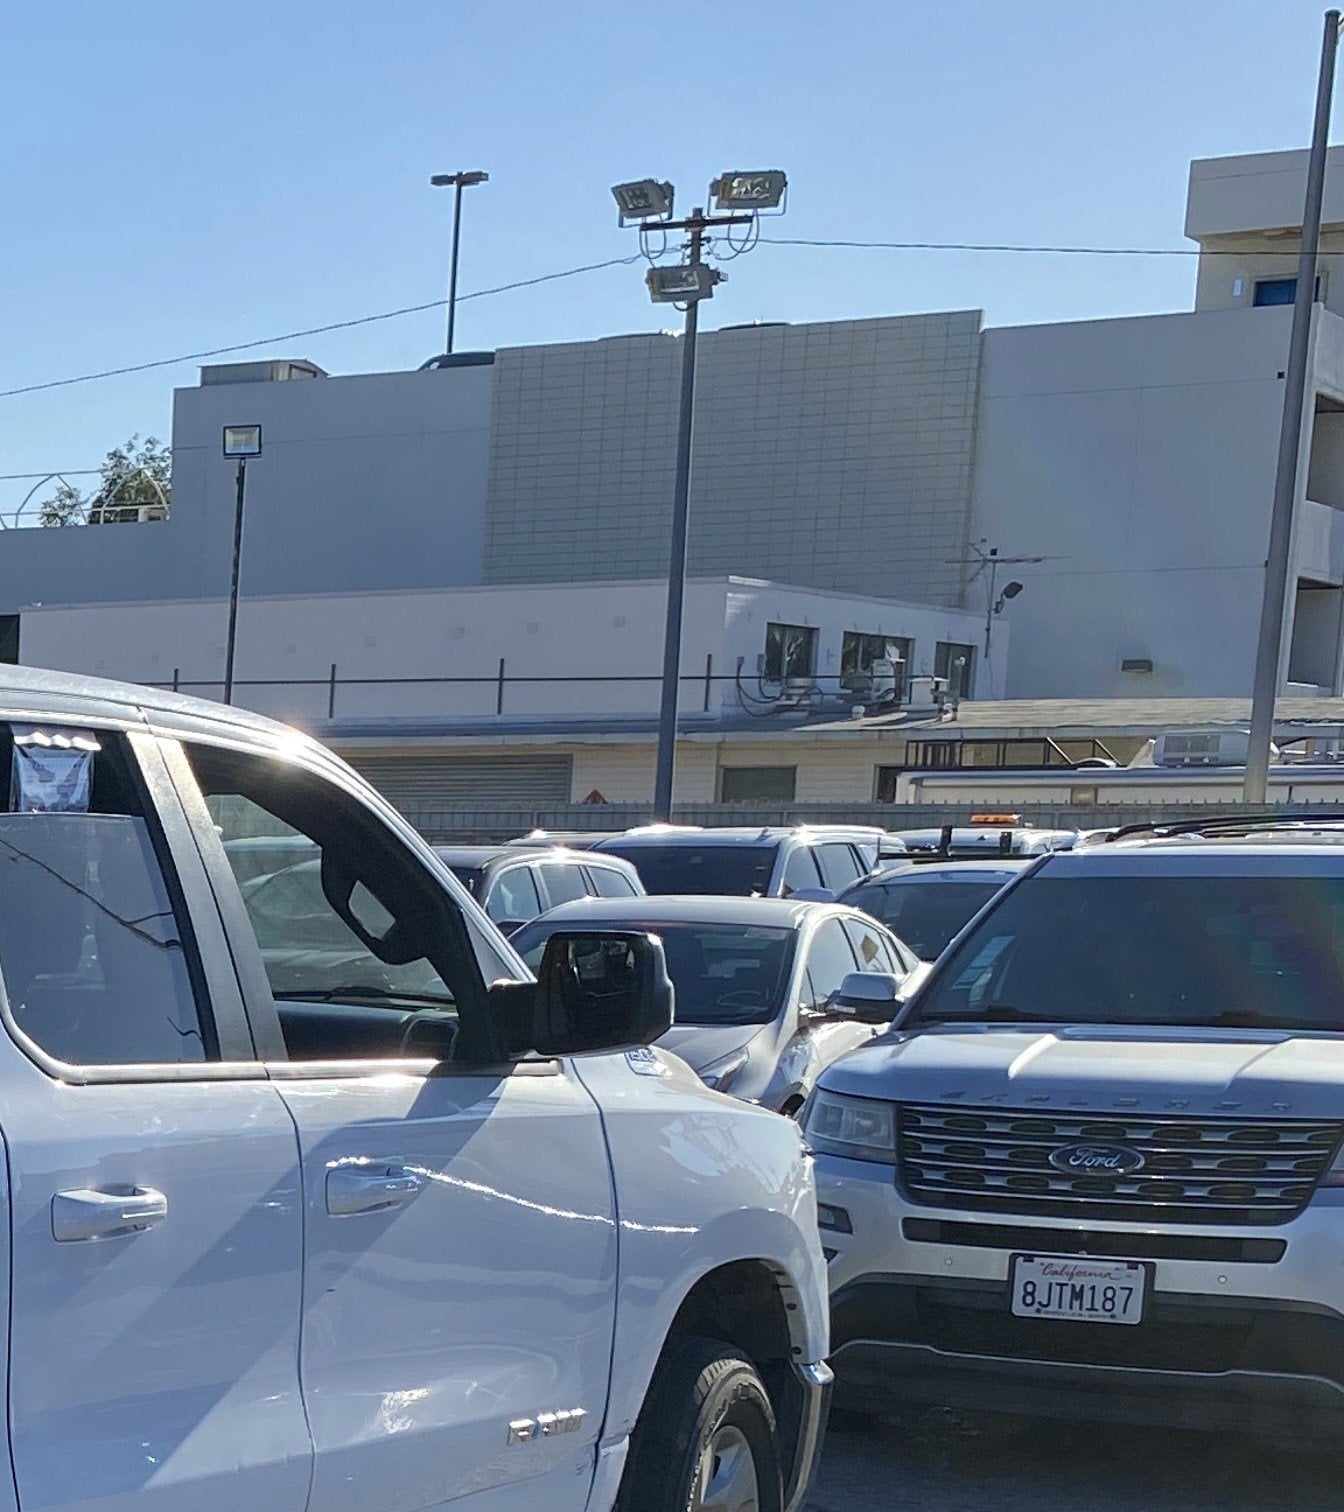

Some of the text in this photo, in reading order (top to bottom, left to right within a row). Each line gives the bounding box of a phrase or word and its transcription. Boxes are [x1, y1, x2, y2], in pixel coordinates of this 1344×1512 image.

[1069, 1146, 1122, 1168] Ford
[1040, 1261, 1113, 1281] California
[1021, 1280, 1134, 1315] 8JTM187
